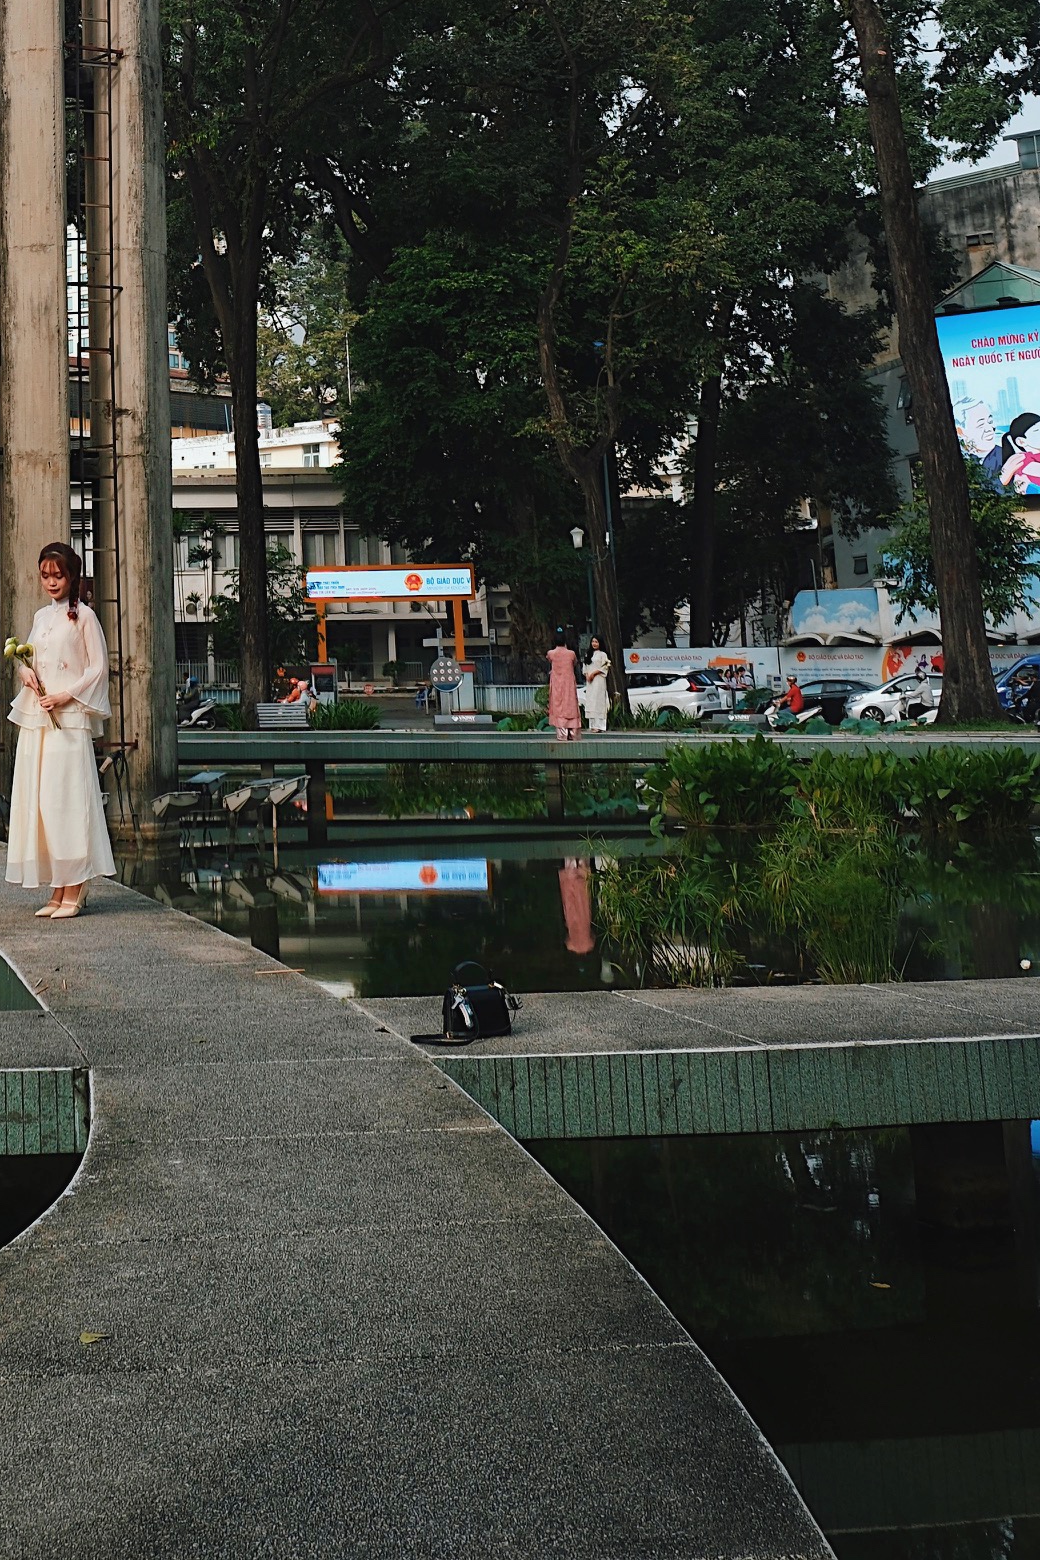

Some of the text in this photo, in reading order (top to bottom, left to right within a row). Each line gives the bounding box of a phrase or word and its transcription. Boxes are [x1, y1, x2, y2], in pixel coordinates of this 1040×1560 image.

[971, 336, 995, 349] CHÀO
[998, 332, 1025, 346] MỪNG
[952, 355, 975, 368] NGÀY
[978, 350, 1003, 365] QUỐC
[1005, 348, 1016, 362] TẾ
